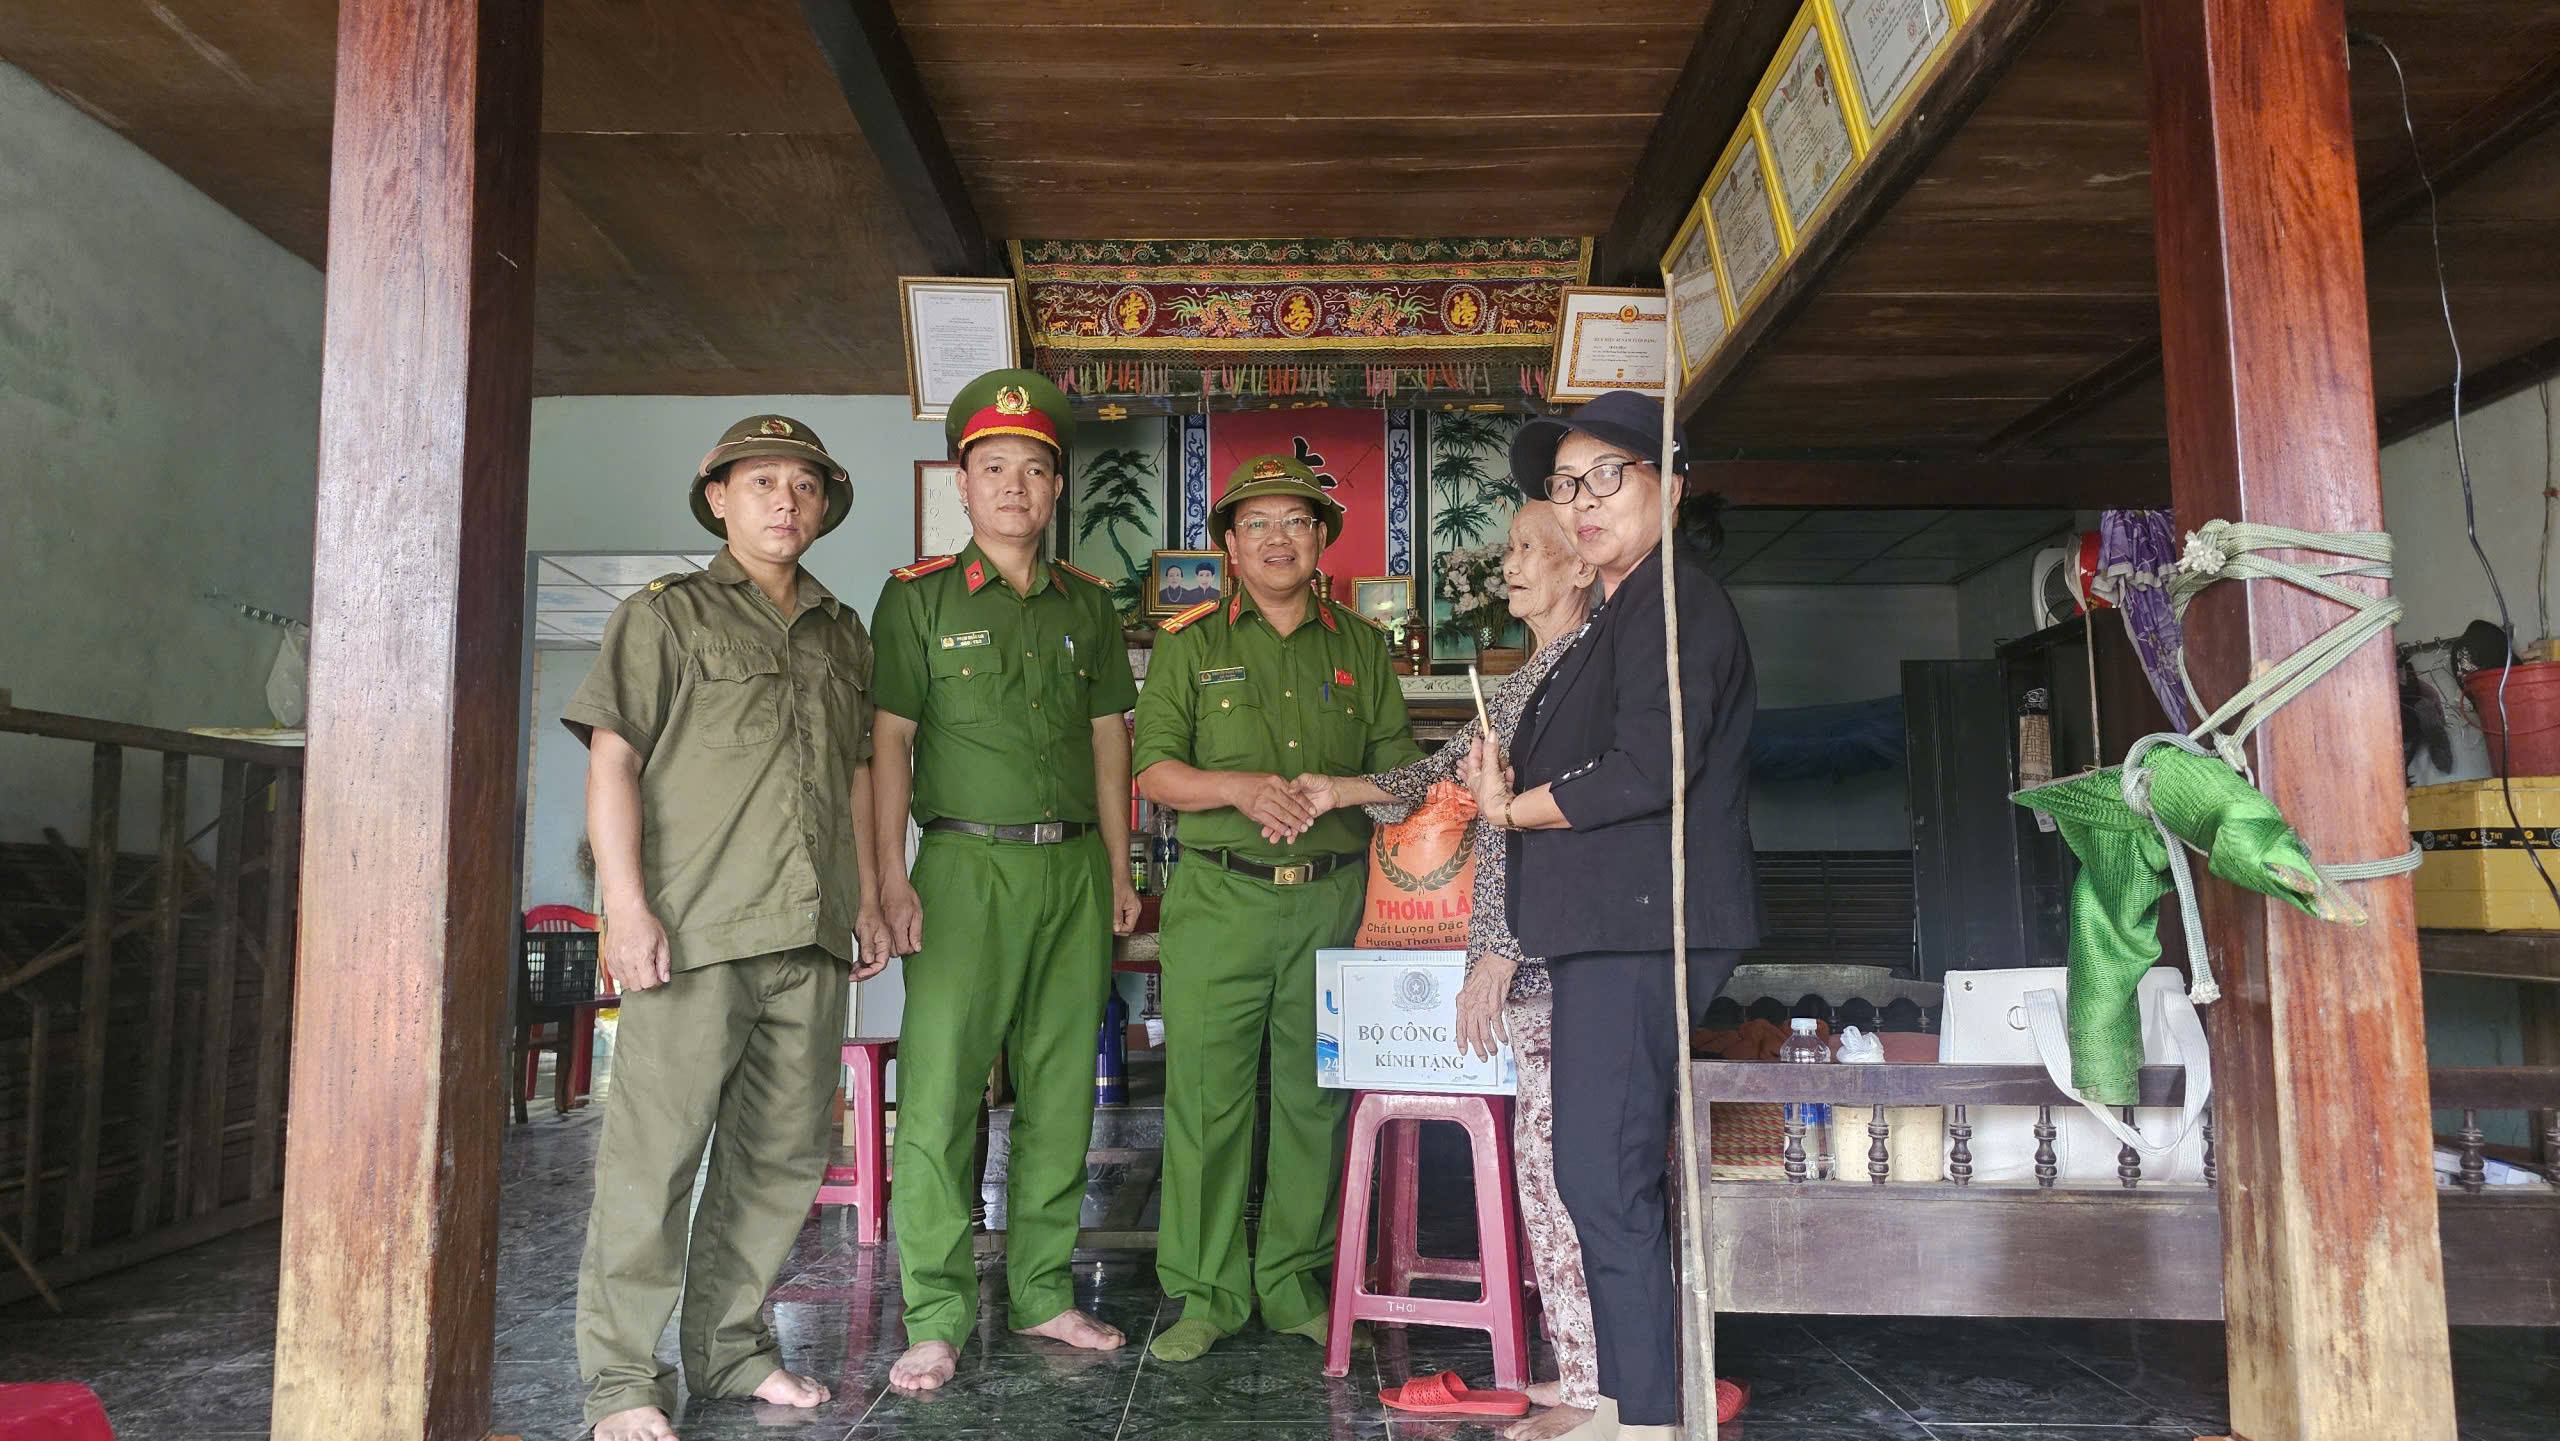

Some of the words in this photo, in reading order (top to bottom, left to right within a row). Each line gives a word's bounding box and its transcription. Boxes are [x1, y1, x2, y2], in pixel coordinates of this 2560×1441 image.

[1376, 897, 1435, 921] THƠM
[1367, 922, 1391, 933] Chất
[1395, 924, 1434, 936] Lượng
[1438, 921, 1464, 932] Đặc
[1366, 937, 1402, 947] Hương
[1405, 938, 1440, 946] Thơm
[1358, 1023, 1385, 1045] BỘ
[1390, 1021, 1447, 1043] CÔNG
[1375, 1050, 1416, 1068] KÍNH
[1419, 1053, 1464, 1072] TẶNG
